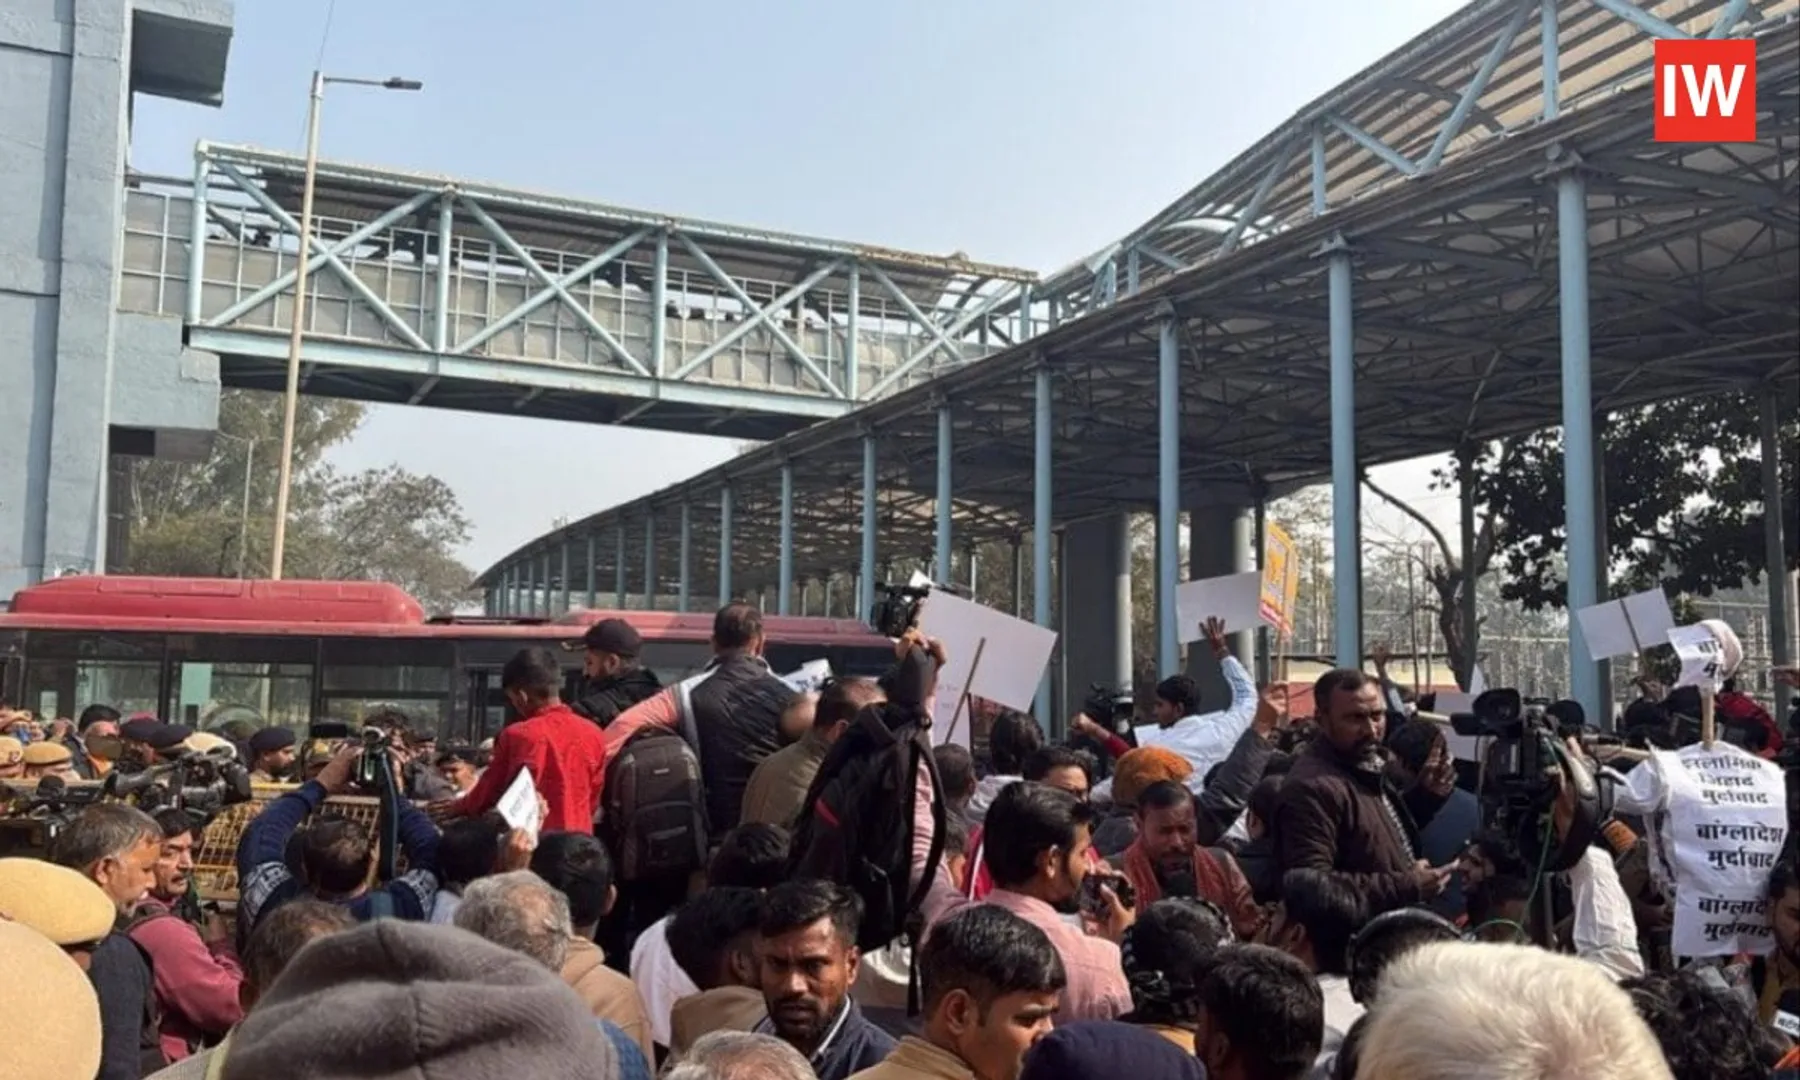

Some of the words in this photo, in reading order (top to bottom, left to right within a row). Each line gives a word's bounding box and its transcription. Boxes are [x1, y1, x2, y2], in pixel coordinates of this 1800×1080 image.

[1695, 820, 1784, 842] बांग्लादेश
[1708, 846, 1775, 871] मुर्दाबाद
[1698, 894, 1769, 915] बांग्लादे
